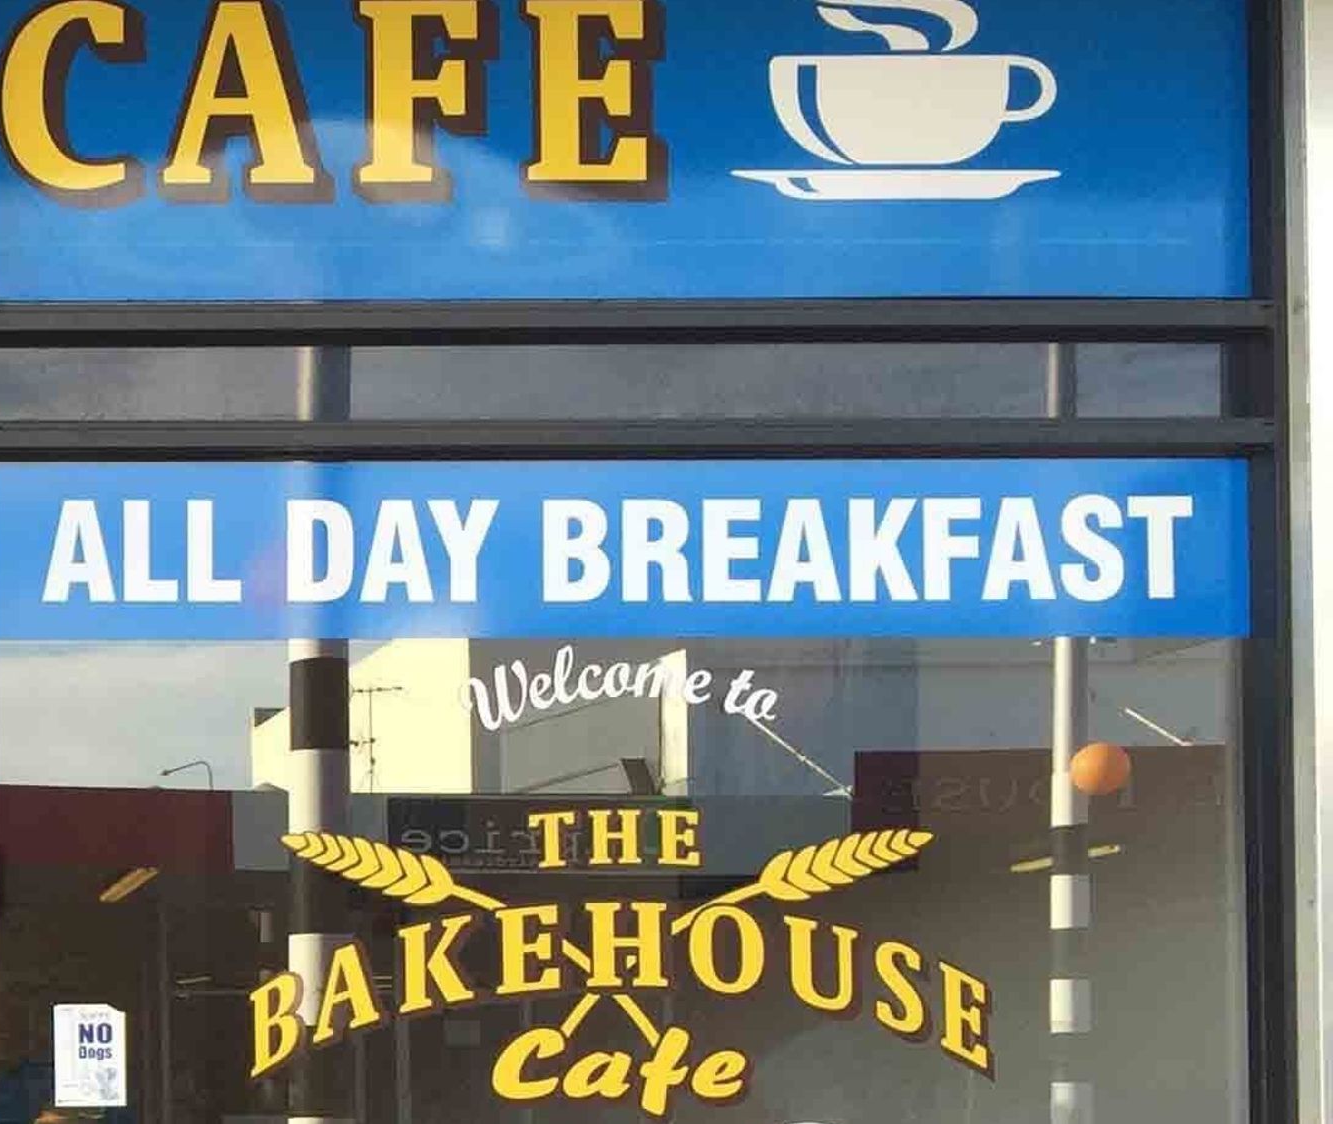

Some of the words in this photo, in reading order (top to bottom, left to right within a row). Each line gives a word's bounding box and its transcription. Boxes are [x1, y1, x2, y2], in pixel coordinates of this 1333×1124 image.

[0, 0, 655, 192] CAFE
[42, 500, 242, 603] ALL
[285, 500, 499, 603] DAY
[542, 495, 1193, 602] BREAKFAST
[460, 644, 712, 731] Welcome
[723, 669, 779, 722] to
[529, 809, 701, 868] THE
[78, 1022, 113, 1044] NO
[250, 902, 993, 1079] BAKEHOUSE
[78, 1045, 112, 1061] Dogs
[491, 1027, 746, 1117] Cafe
